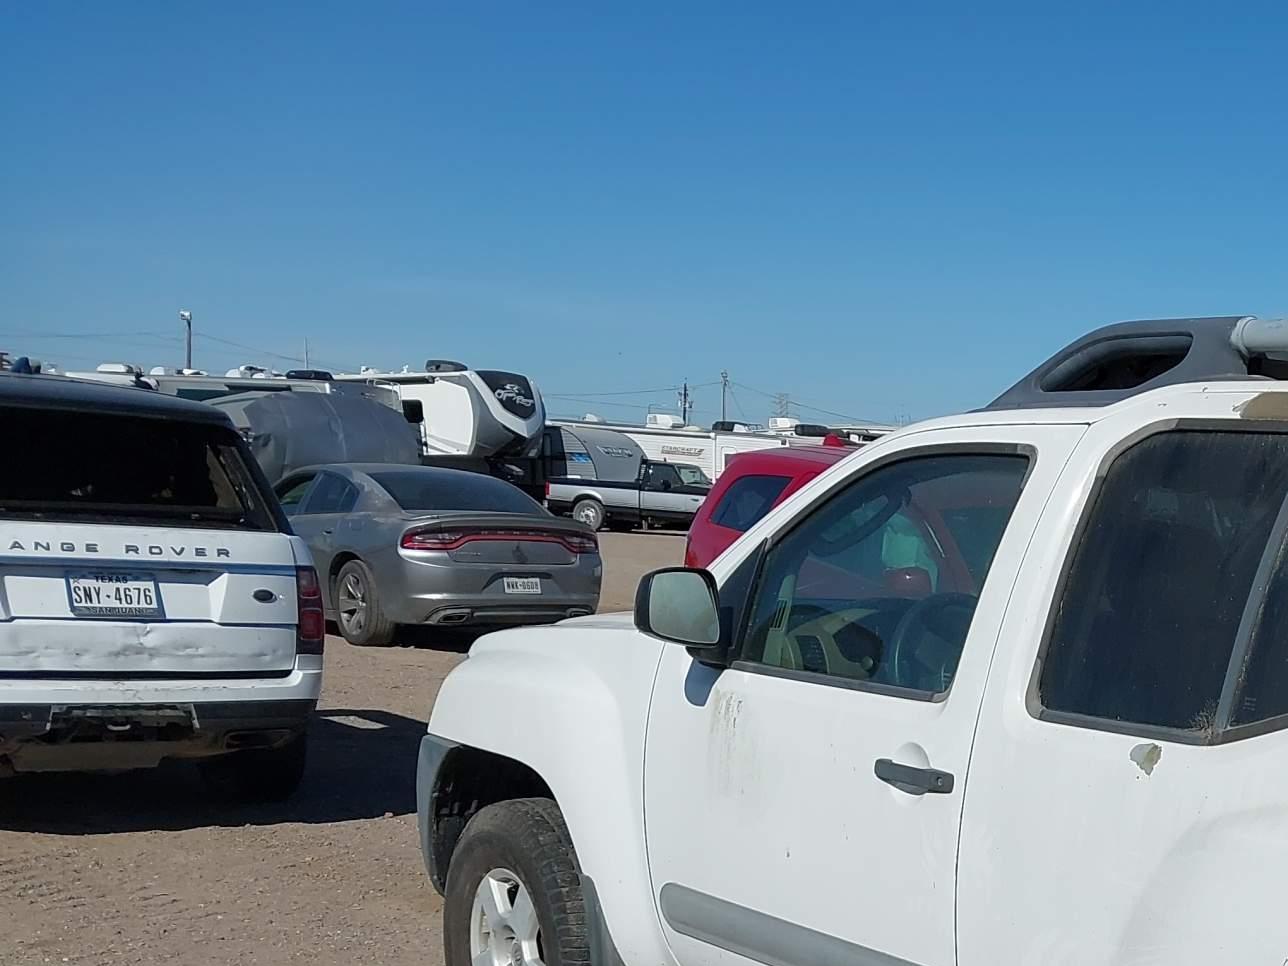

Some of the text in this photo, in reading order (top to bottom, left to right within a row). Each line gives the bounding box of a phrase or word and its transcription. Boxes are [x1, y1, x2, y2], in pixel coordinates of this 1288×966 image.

[8, 540, 231, 558] ANGE ROVER
[94, 575, 128, 584] TEXAS
